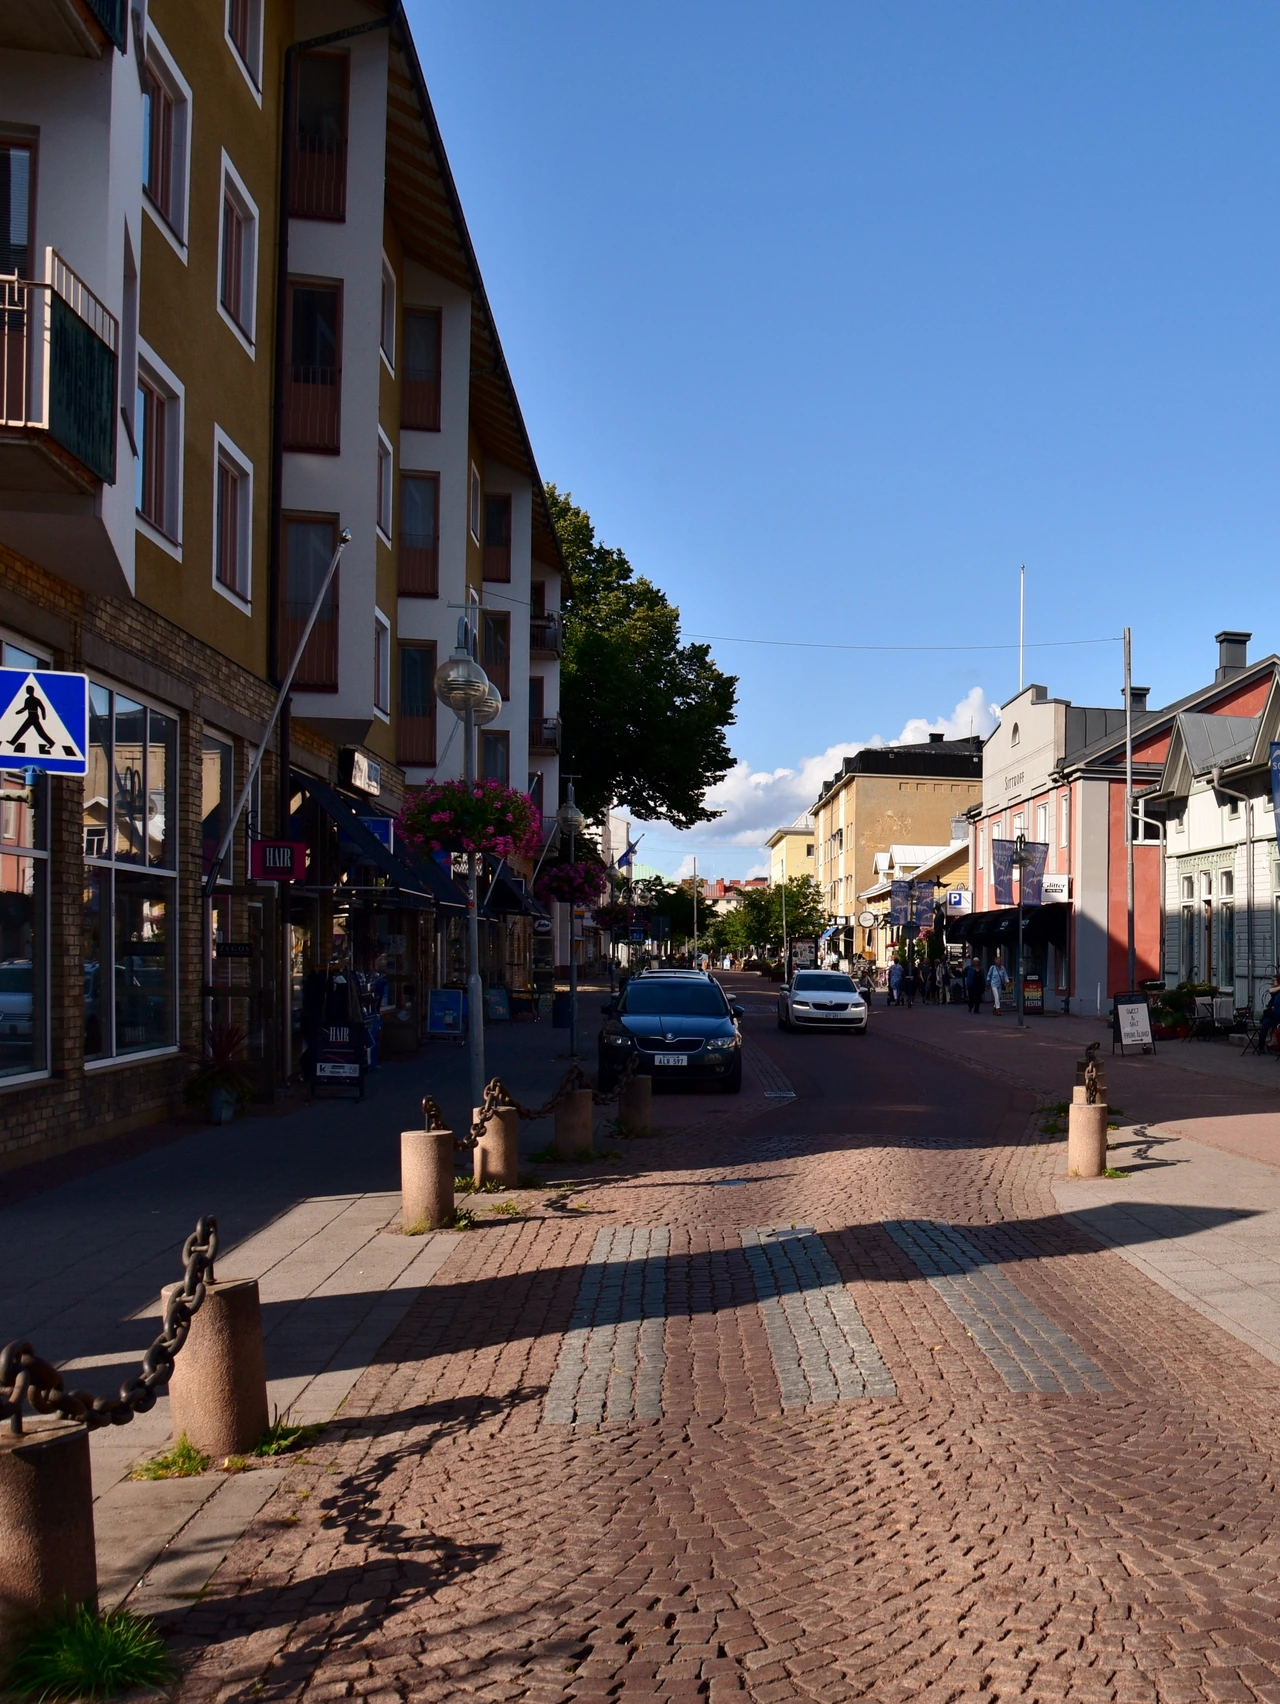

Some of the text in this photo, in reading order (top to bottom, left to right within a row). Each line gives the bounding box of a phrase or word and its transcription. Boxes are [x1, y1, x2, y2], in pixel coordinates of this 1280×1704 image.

[265, 847, 292, 867] HAIR
[951, 894, 960, 904] P
[329, 1026, 349, 1042] HAIR
